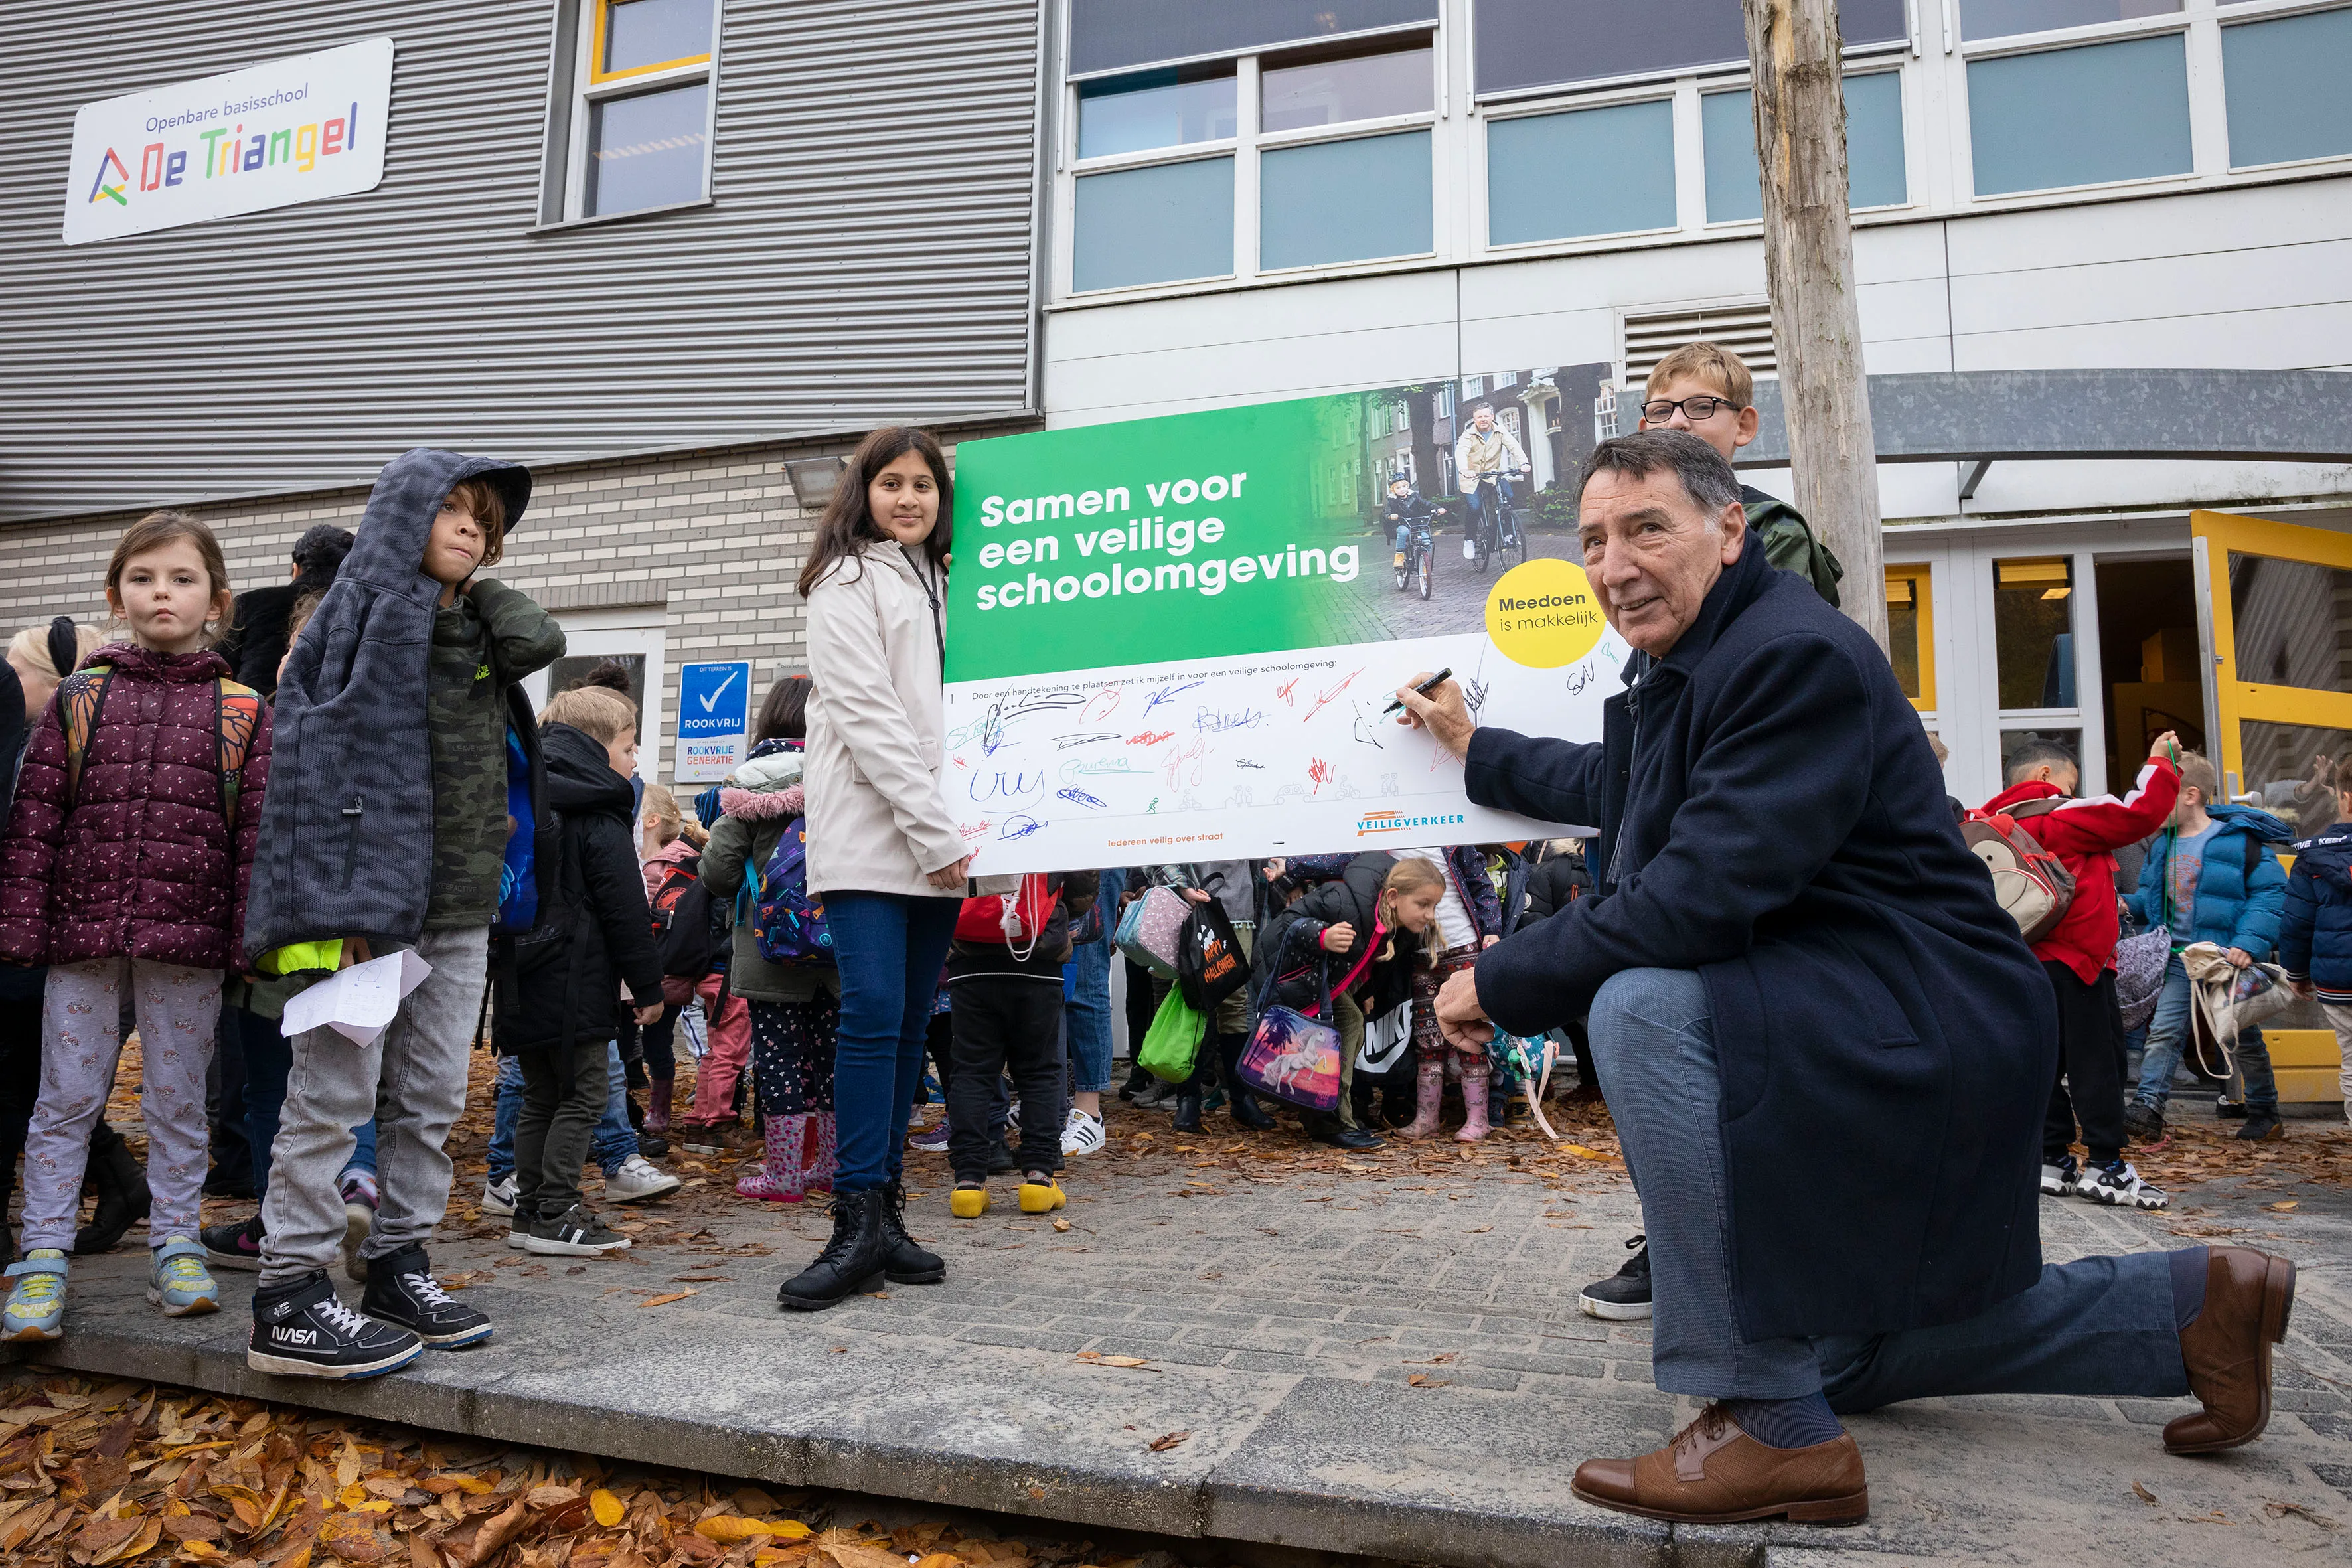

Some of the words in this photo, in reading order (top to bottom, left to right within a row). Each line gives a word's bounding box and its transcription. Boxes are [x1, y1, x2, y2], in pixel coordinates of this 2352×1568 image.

[145, 108, 218, 133] Openbare
[223, 82, 309, 116] basisschool
[139, 142, 187, 192] De
[200, 101, 358, 179] Triangel
[980, 486, 1130, 527] Samen
[1146, 472, 1247, 507] voor
[979, 536, 1059, 568] een
[1074, 517, 1225, 556] veilige
[977, 543, 1360, 611] schoolomgeving
[1499, 594, 1586, 611] Meedoen
[1500, 619, 1512, 631] is
[1518, 610, 1598, 629] makkelijk
[432, 674, 452, 683] TIVE
[1012, 684, 1069, 696] handtekening
[1083, 680, 1119, 691] plaatsen
[1147, 673, 1175, 684] mijzelf
[1229, 666, 1258, 676] veilige
[1261, 659, 1337, 673] schoolomgeving:
[684, 718, 740, 728] ROOKVRIJ
[687, 745, 734, 755] ROOKVRIJE
[687, 755, 734, 765] GENERATIE
[1107, 838, 1147, 847] Iedereen
[1150, 836, 1173, 845] veilig
[1197, 832, 1223, 841] straat
[2291, 840, 2312, 850] TIVE
[2318, 835, 2347, 846] KEEP
[1366, 998, 1413, 1056] NIKE
[272, 1326, 317, 1345] NASA
